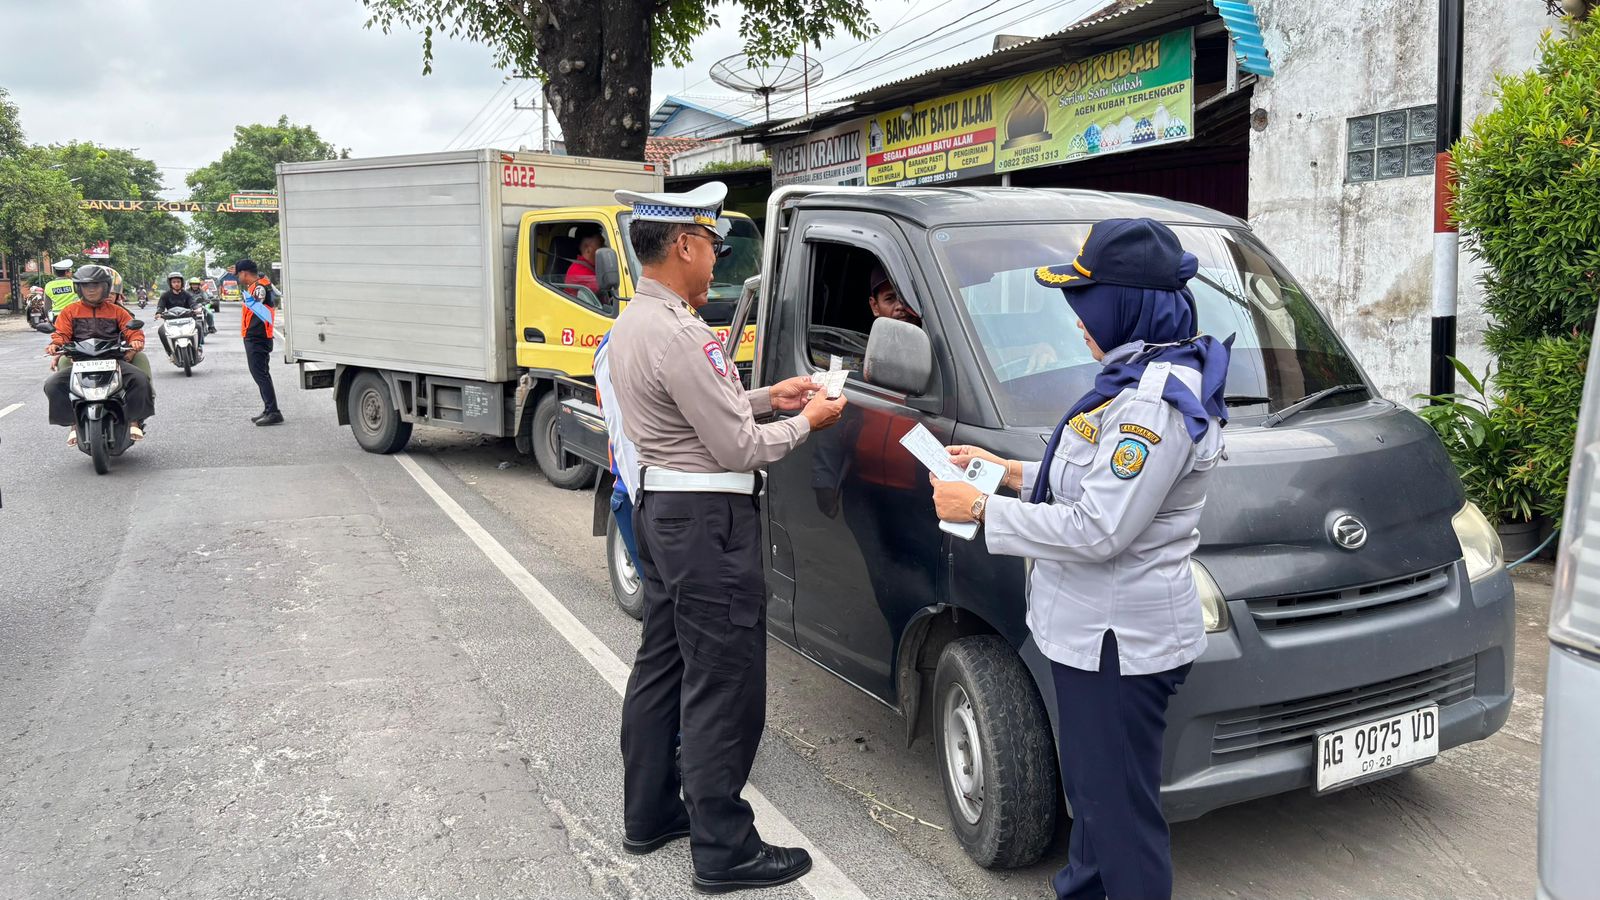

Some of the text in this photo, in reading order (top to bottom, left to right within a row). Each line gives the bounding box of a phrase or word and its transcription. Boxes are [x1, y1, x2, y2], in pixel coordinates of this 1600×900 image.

[1045, 39, 1160, 97] 1001 KUBAH
[1058, 75, 1143, 108] Seribu Satu Kubah
[1074, 83, 1185, 117] AGEN KUBAH TERLENGKAP
[886, 92, 993, 145] BANGKIT BATU ALAM
[777, 130, 860, 176] AGEN KRAMIK
[883, 134, 973, 162] SEGALA MACAM BATU ALAM
[953, 145, 988, 158] PENGIRIMAN
[1014, 145, 1042, 157] HUBUNGI
[908, 154, 944, 167] BARANG PASTI
[961, 156, 979, 166] CEPAT
[1003, 150, 1059, 168] 0822 2853 1313
[503, 165, 536, 188] G022
[914, 165, 937, 175] LENGKAP
[157, 201, 201, 212] KOTA
[52, 286, 72, 295] POLISI
[1323, 710, 1435, 770] AG 9075 VD
